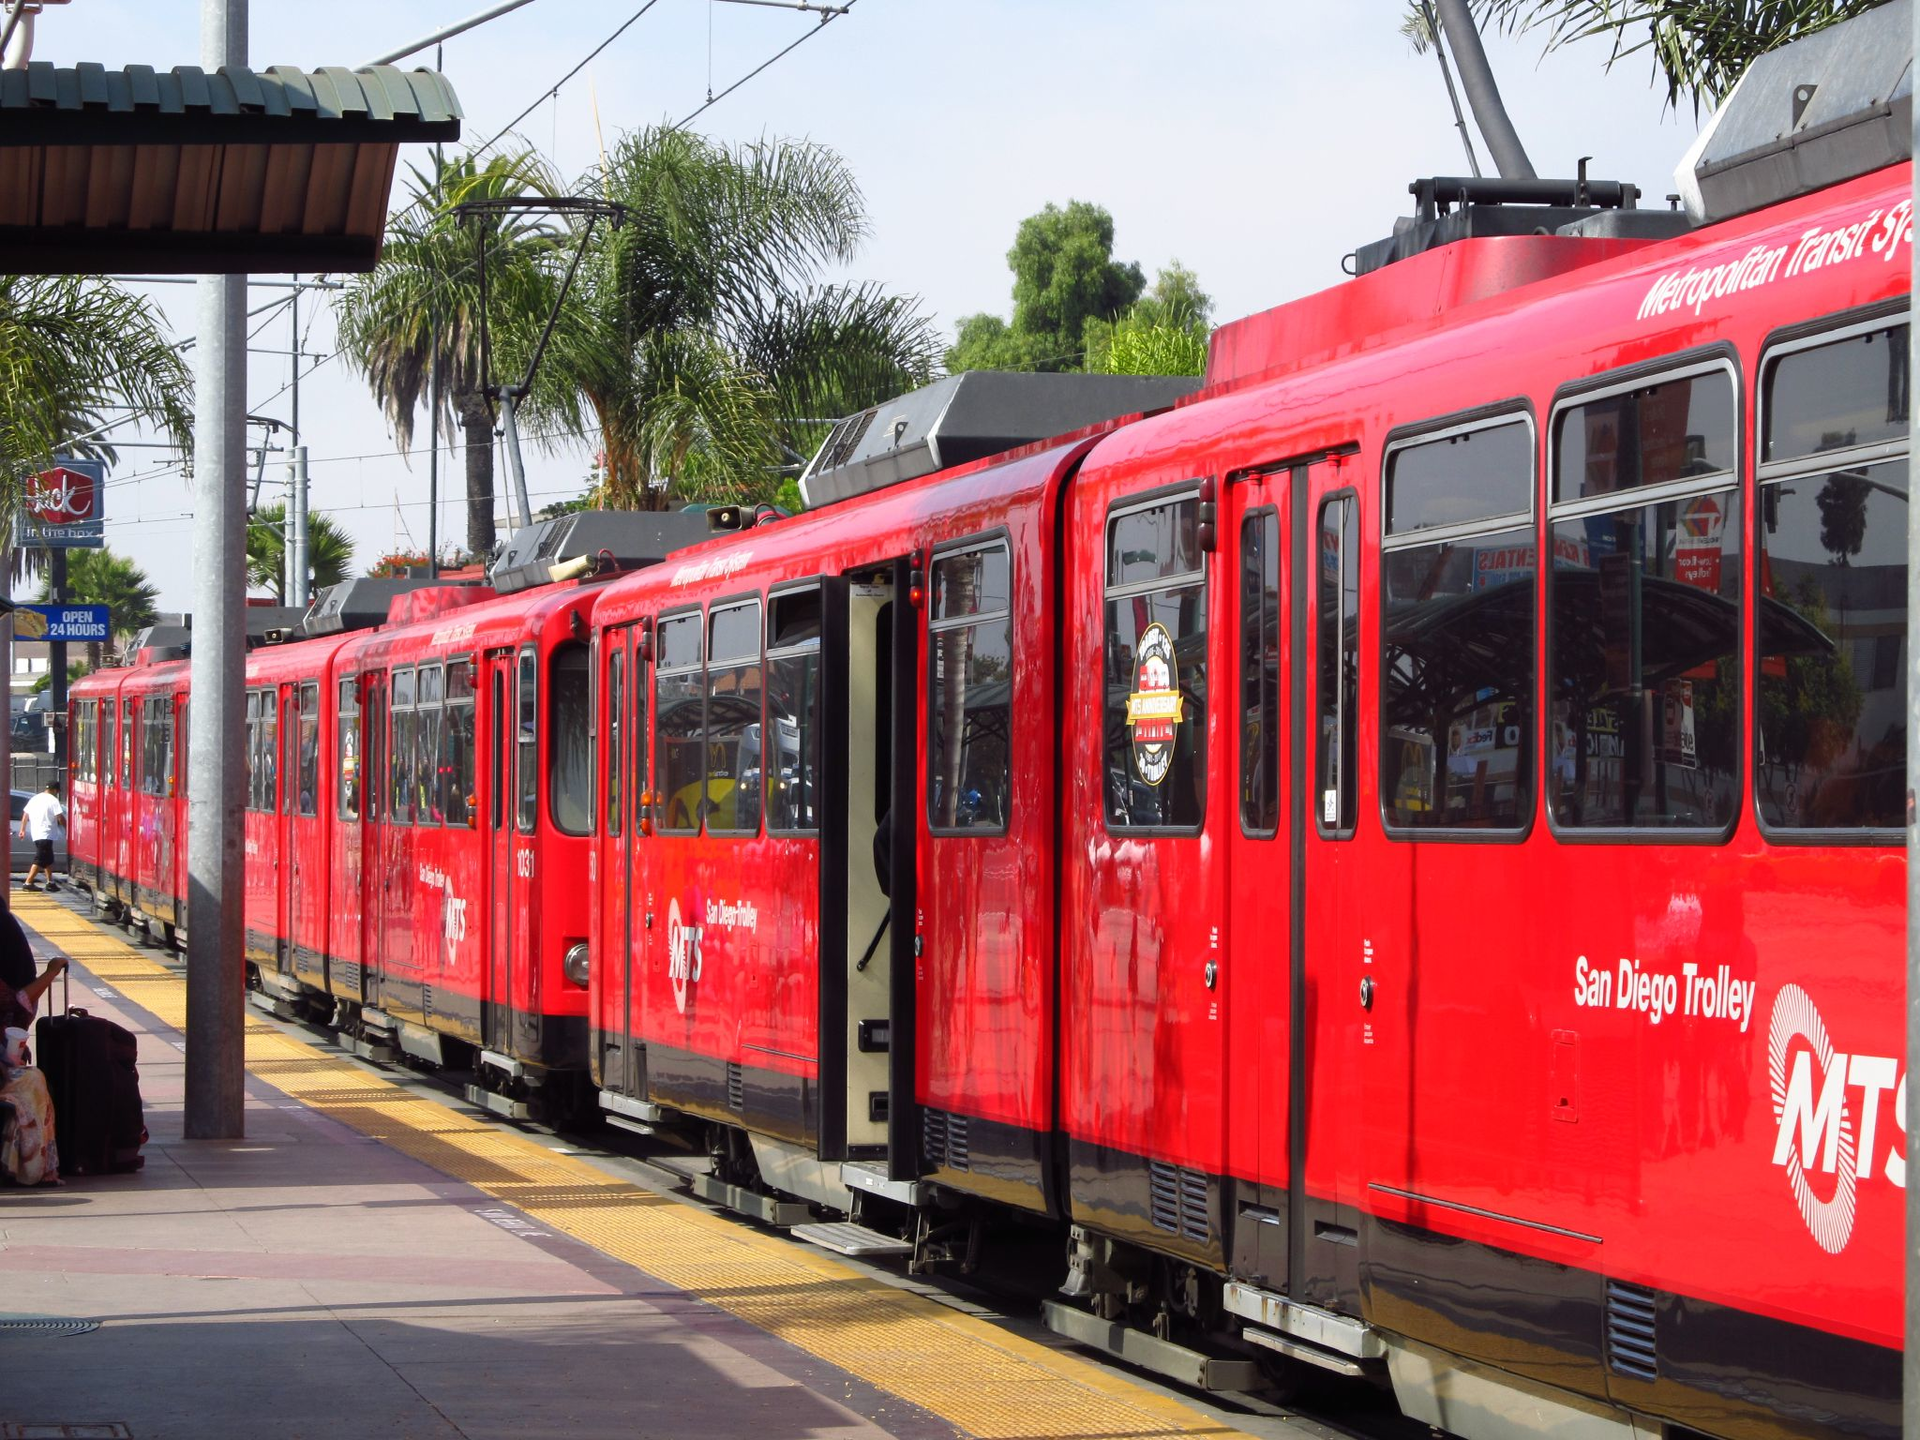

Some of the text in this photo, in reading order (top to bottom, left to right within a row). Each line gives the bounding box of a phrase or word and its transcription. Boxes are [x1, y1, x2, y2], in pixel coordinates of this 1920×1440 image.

[1636, 245, 1788, 320] Metropolitan
[1784, 209, 1885, 278] Transit
[50, 624, 105, 636] 24 HOURS
[62, 611, 93, 623] OPEN
[517, 849, 535, 878] 1031
[445, 897, 467, 942] MTS
[706, 898, 758, 935] San Diego Trolley
[668, 926, 704, 983] MTS
[1574, 955, 1756, 1033] San Diego Trolley
